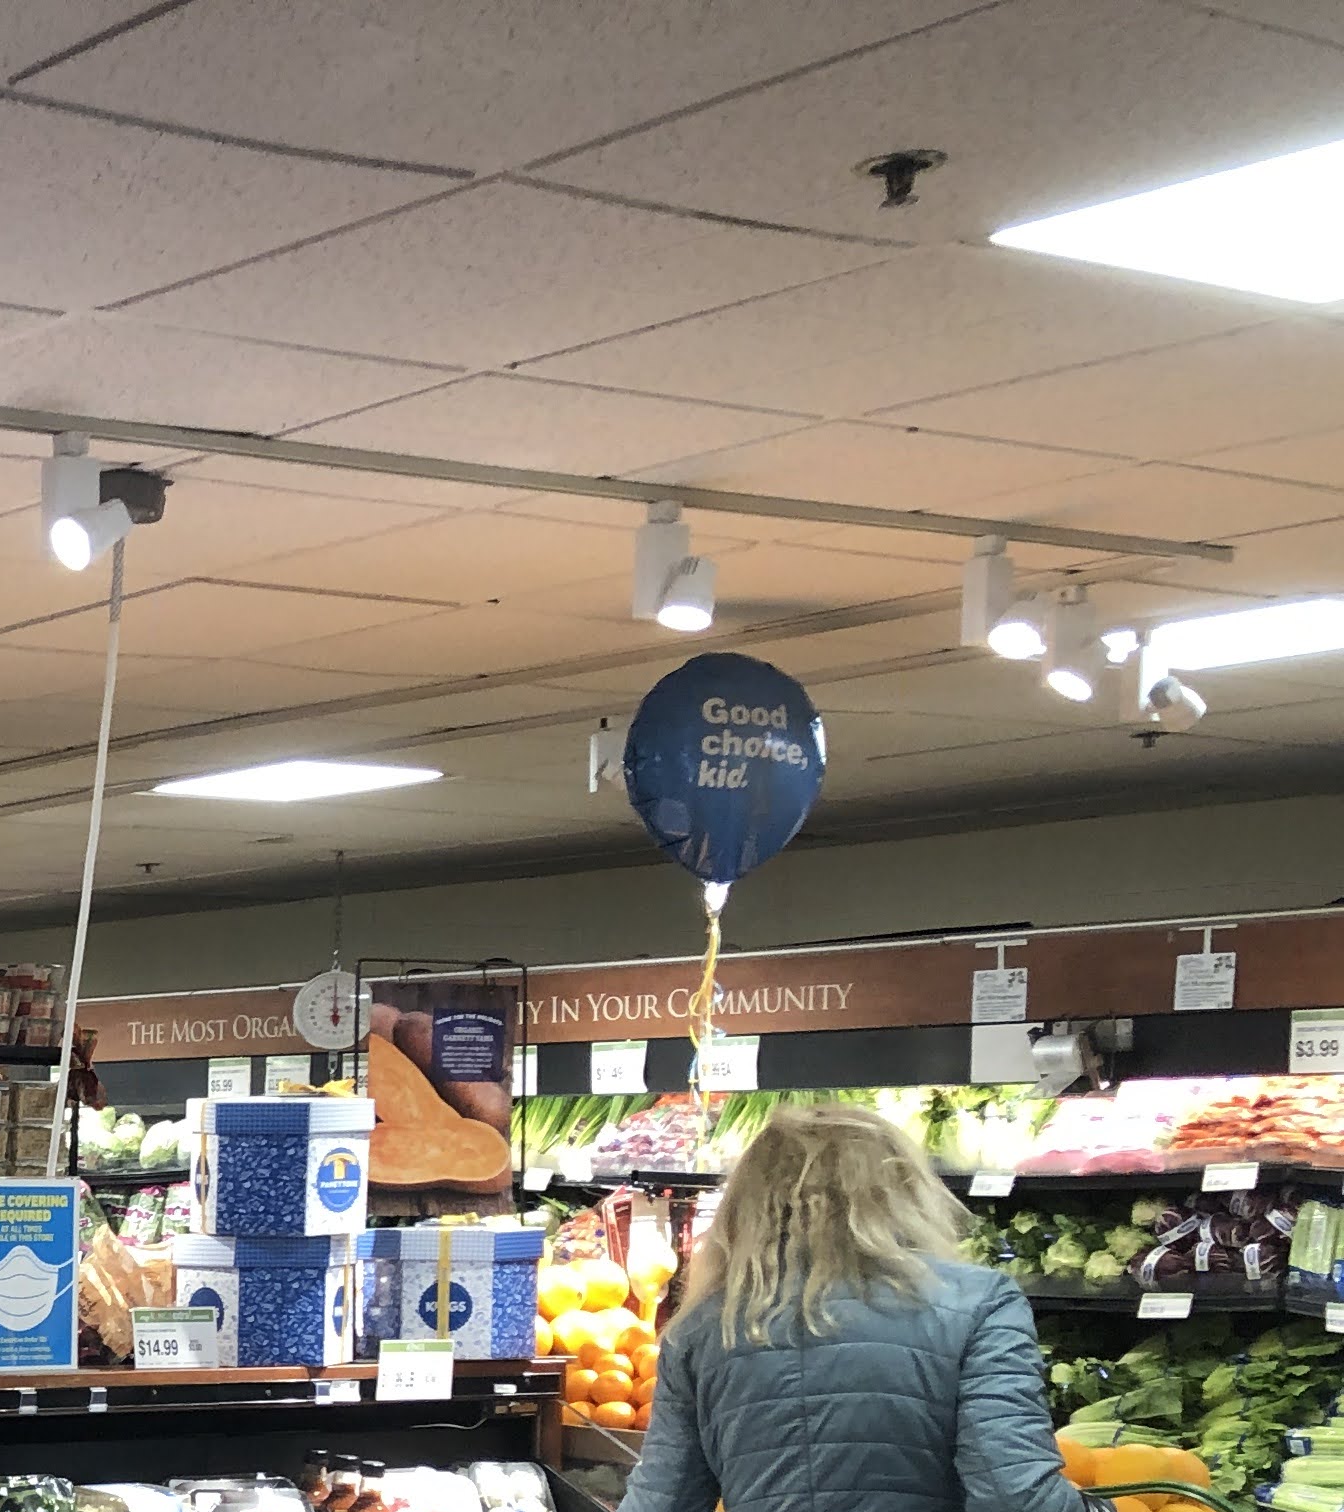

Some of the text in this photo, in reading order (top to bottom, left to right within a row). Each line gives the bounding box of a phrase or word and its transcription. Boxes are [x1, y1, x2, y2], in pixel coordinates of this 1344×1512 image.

[702, 697, 787, 730] Good
[701, 729, 809, 771] choice,
[698, 760, 749, 788] kid.
[551, 996, 579, 1024] IN
[587, 992, 662, 1022] YOUR
[667, 983, 854, 1018] COMMUNITY
[127, 1021, 165, 1046] THE
[171, 1019, 228, 1044] MOST
[1296, 1040, 1339, 1058] $3.99
[210, 1079, 233, 1093] $5.99
[7, 1195, 68, 1208] COVERING
[425, 1301, 467, 1313] KGS
[138, 1339, 179, 1358] $14.99
